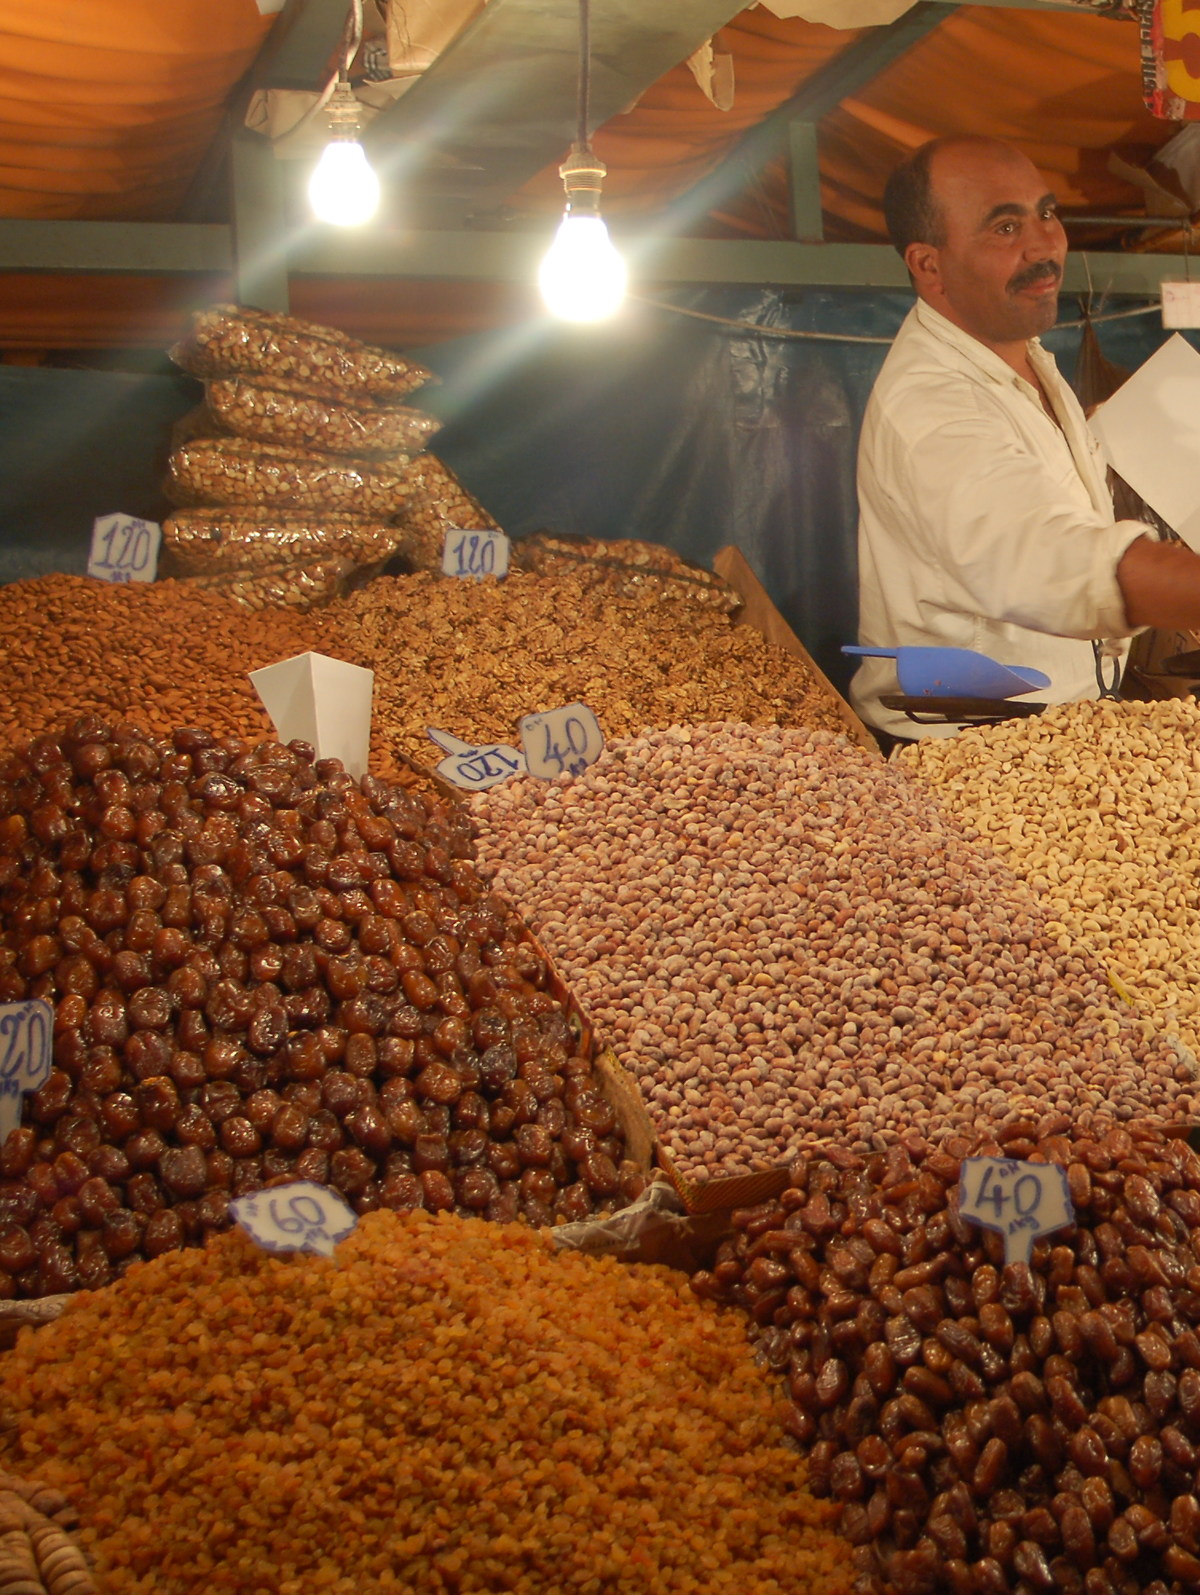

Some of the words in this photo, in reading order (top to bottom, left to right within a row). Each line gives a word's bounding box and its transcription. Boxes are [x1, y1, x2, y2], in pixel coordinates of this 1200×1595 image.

[94, 521, 151, 572] 120
[453, 535, 495, 574] 120
[456, 747, 519, 782] 120
[543, 718, 588, 773] 40
[974, 1165, 1042, 1218] 40
[268, 1195, 327, 1234] 60
